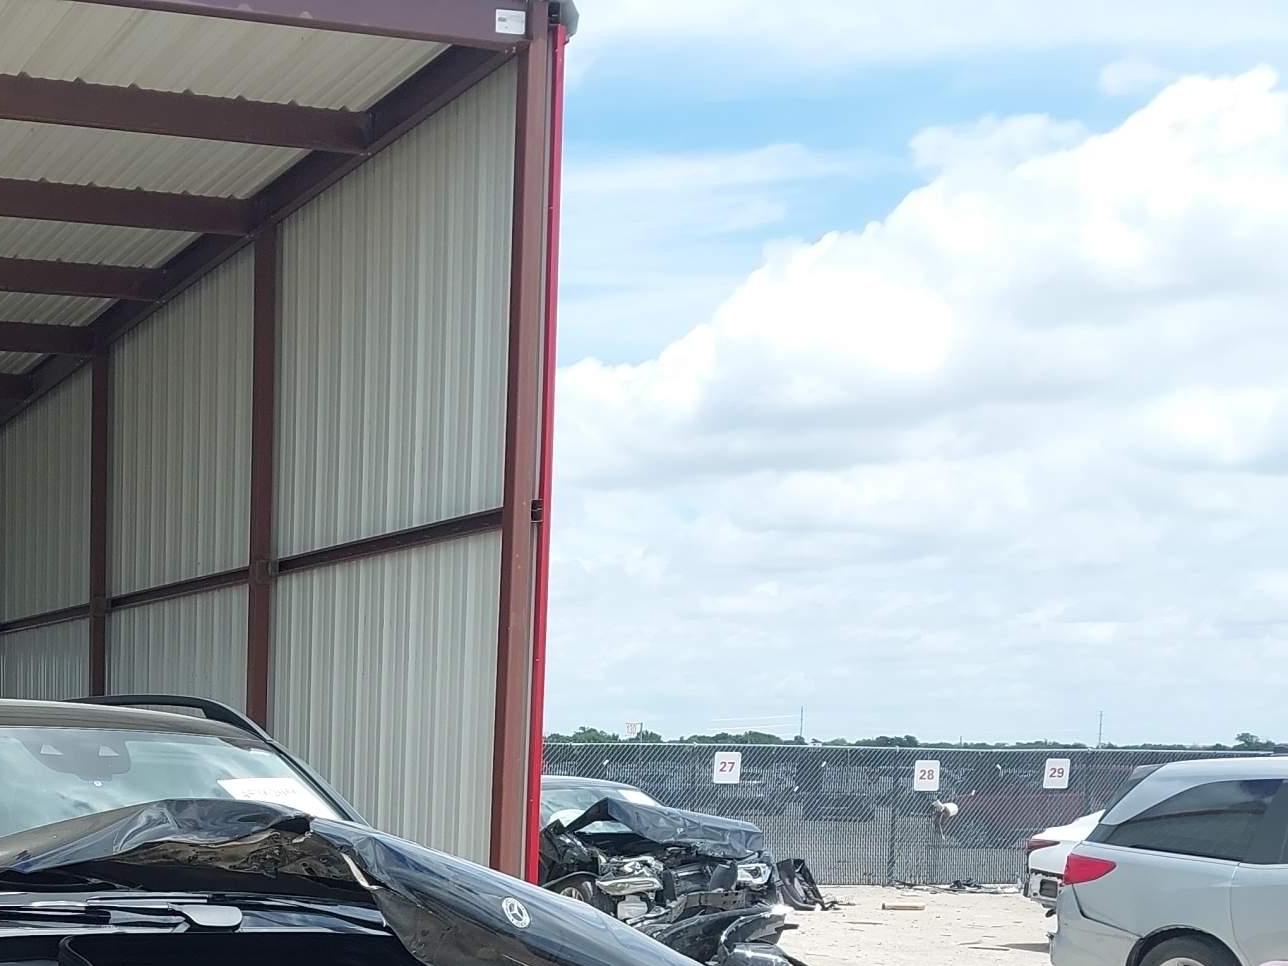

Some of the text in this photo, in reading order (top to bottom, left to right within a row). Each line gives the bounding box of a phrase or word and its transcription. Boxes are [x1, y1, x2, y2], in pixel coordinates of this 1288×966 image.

[719, 761, 736, 772] 27
[919, 769, 934, 780] 28
[1049, 767, 1064, 778] 29
